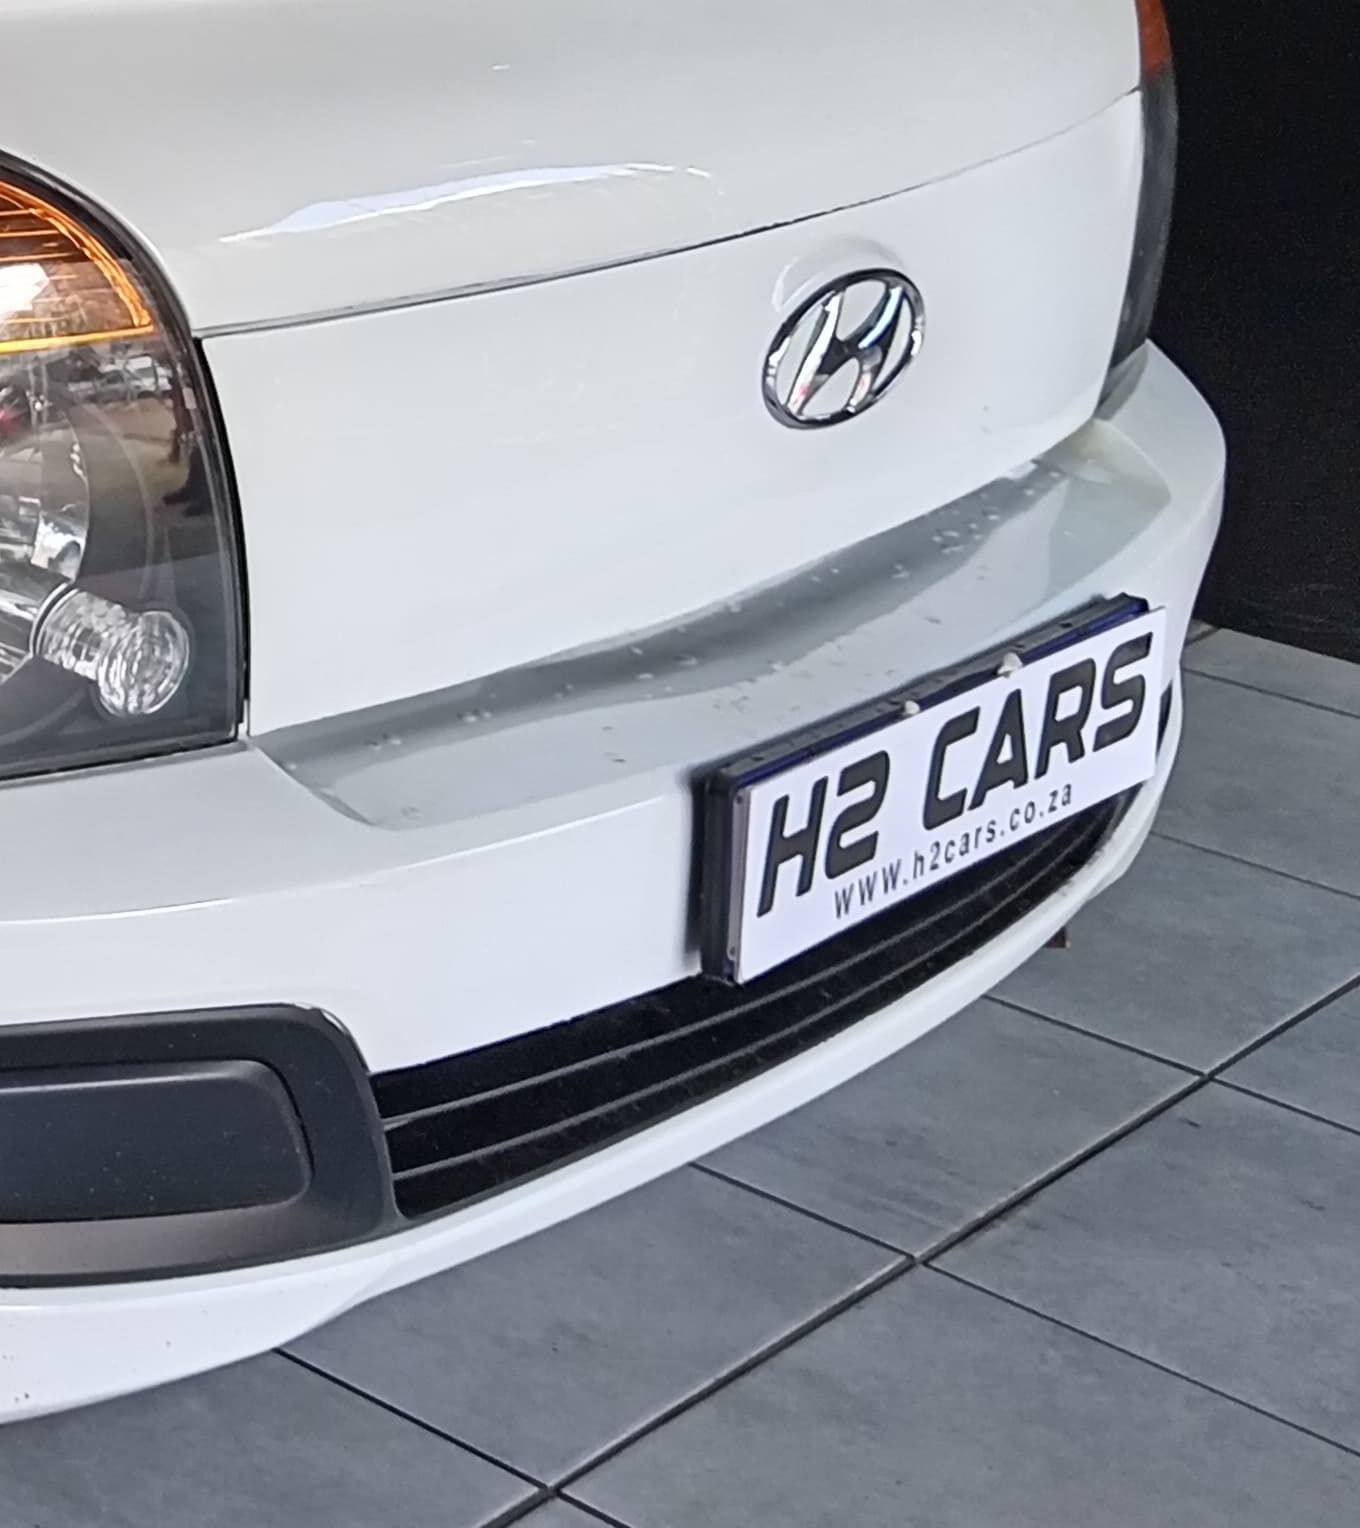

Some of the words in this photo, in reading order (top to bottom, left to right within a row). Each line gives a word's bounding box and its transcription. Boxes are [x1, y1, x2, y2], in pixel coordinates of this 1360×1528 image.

[756, 749, 891, 919] H2
[922, 631, 1154, 832] CARS
[832, 783, 1074, 920] www.h2cars.co.za
